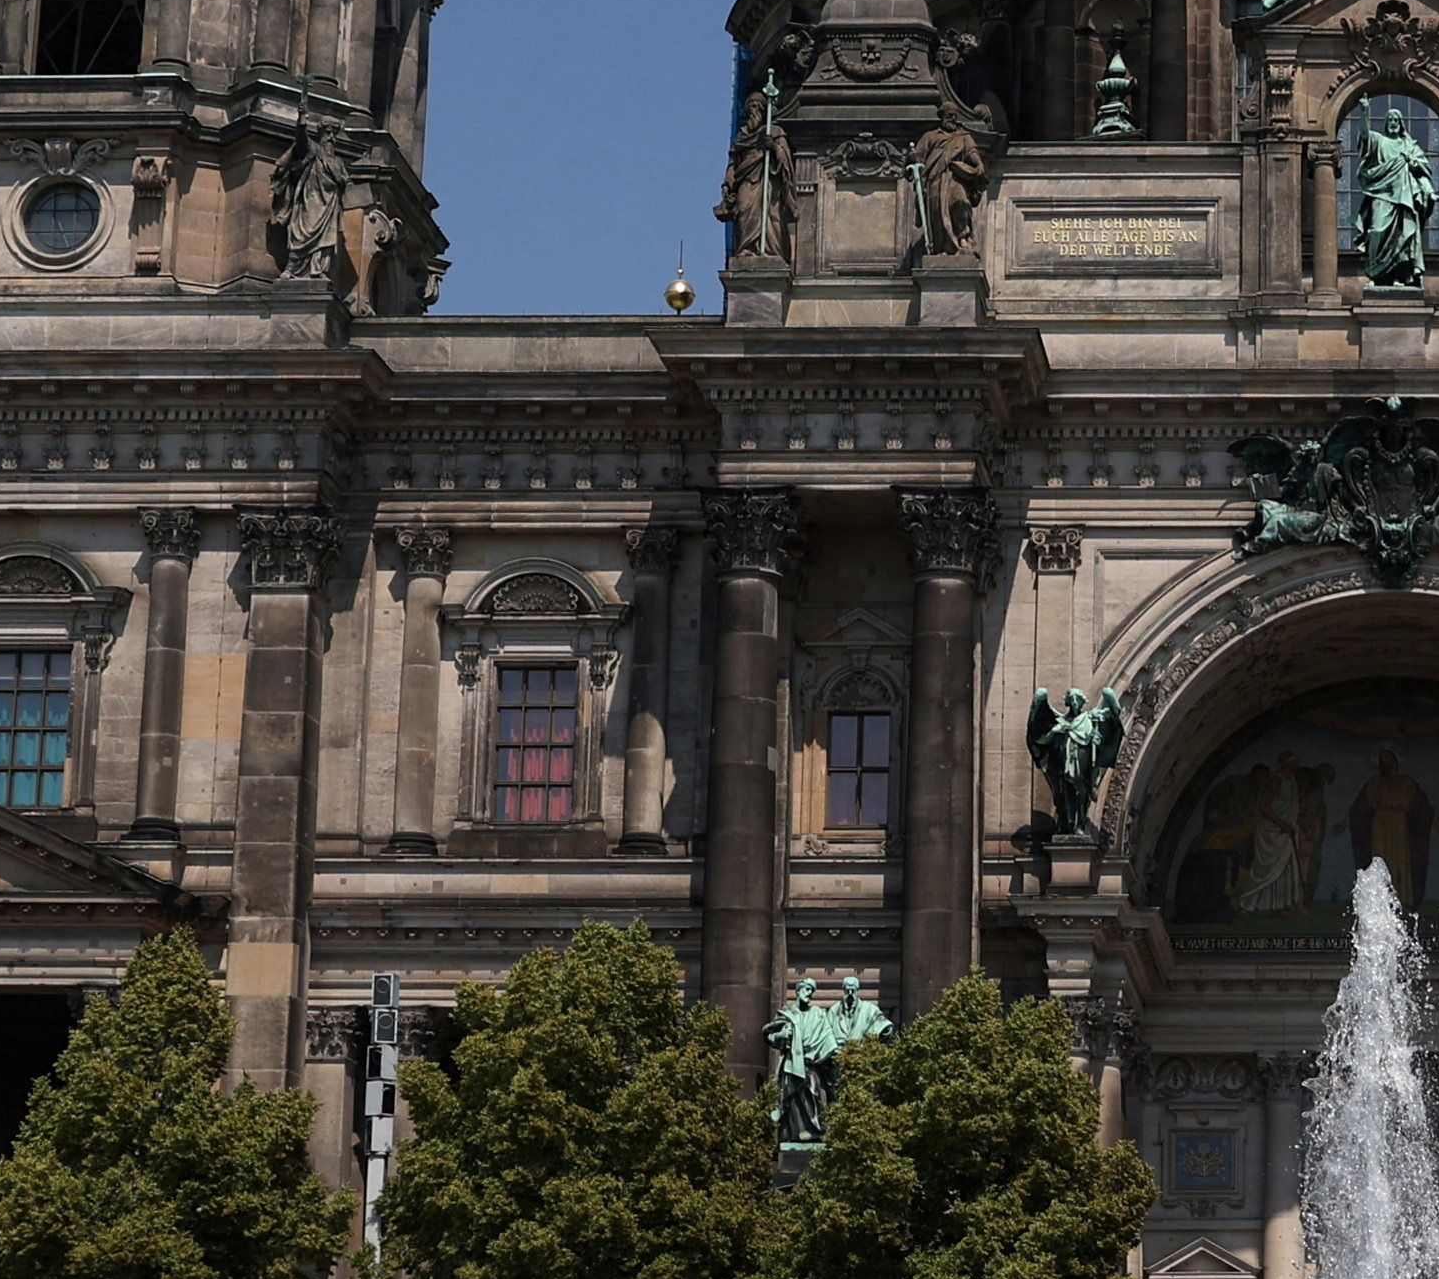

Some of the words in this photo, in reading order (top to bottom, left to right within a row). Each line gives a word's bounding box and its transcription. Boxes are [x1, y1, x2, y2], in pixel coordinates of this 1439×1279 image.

[1099, 218, 1123, 229] ICH
[1128, 218, 1153, 229] BIN
[1158, 218, 1181, 229] BEI
[1033, 231, 1070, 243] EUCH
[1074, 231, 1109, 243] ALLE
[1113, 231, 1147, 243] TAGE
[1152, 231, 1175, 243] BIS
[1178, 231, 1199, 243] AN
[1060, 244, 1088, 256] DER
[1093, 244, 1129, 256] WELT
[1134, 244, 1177, 257] ENDE.
